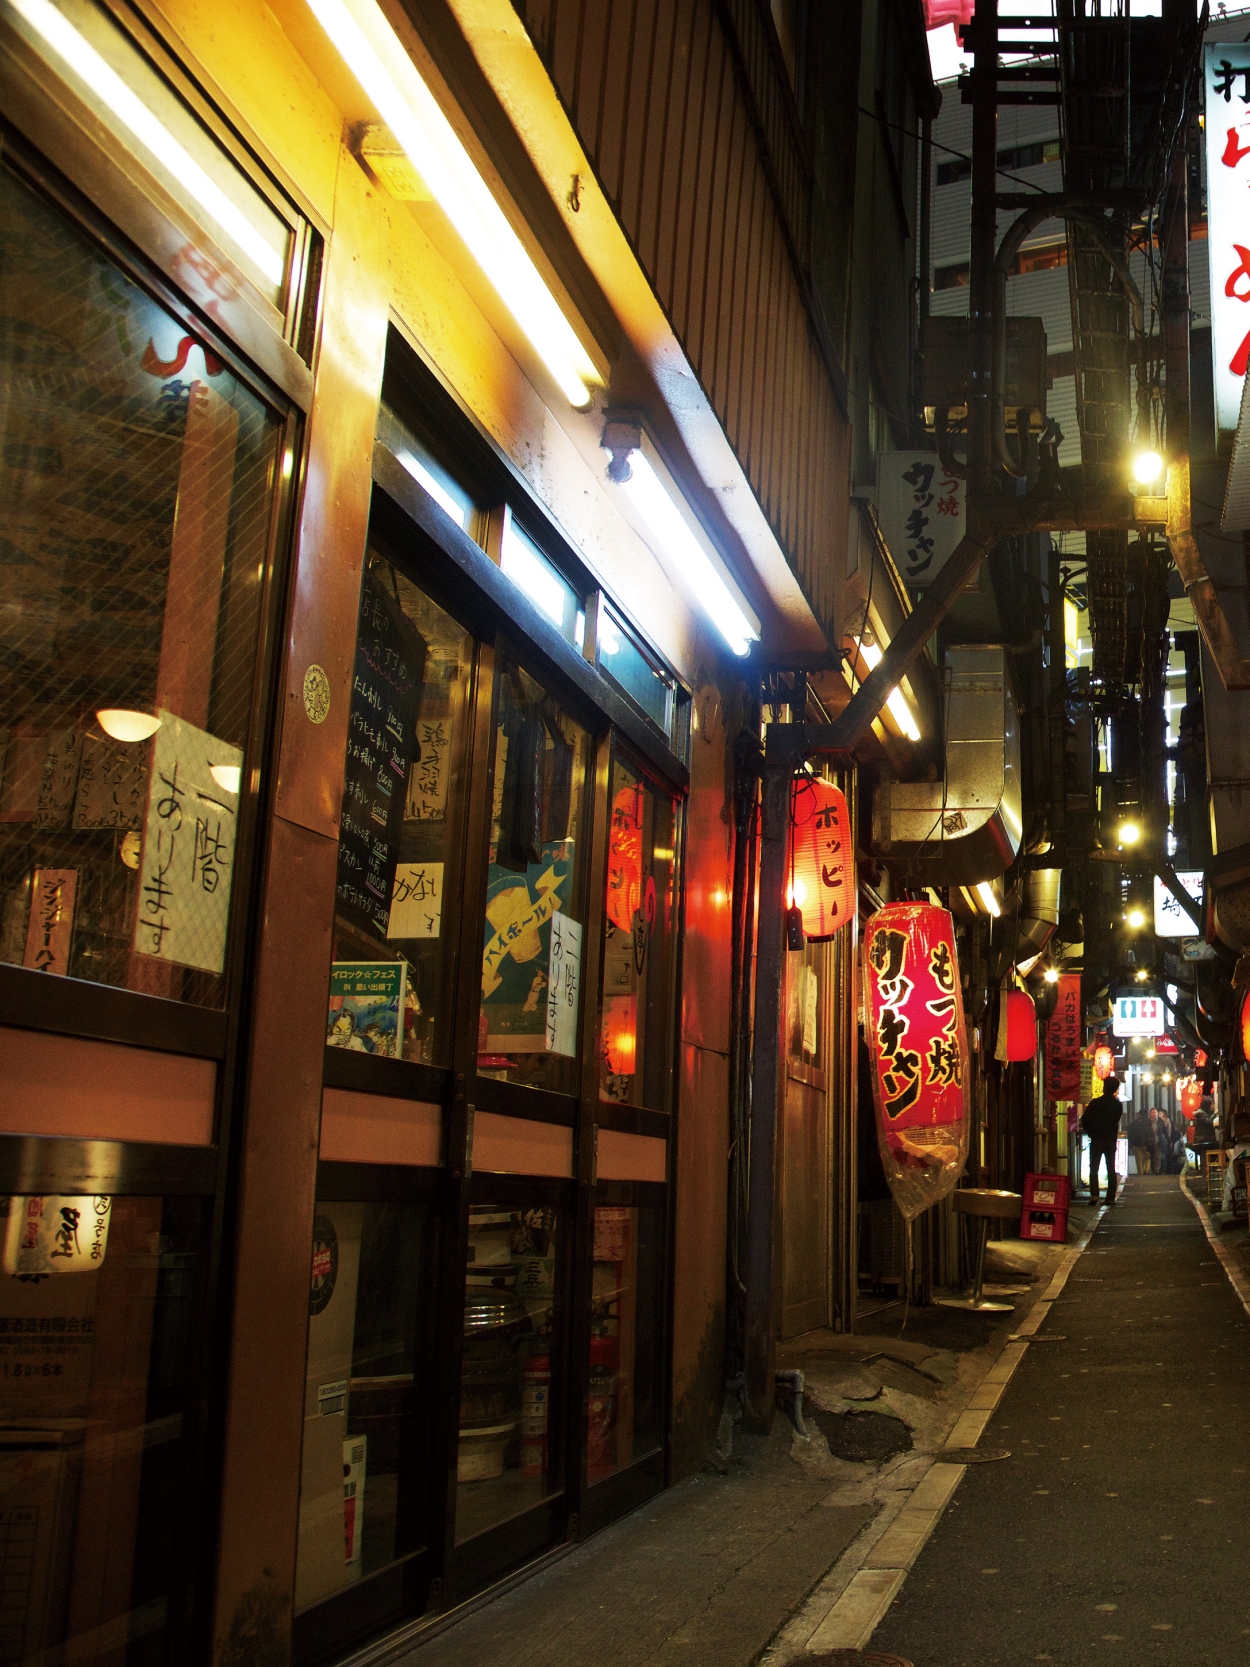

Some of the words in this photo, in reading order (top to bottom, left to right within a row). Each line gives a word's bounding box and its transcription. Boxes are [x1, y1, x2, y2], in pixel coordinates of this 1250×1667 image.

[901, 462, 936, 577] ウッチャン
[139, 761, 186, 955] あります
[815, 805, 844, 916] ホッピー
[343, 983, 351, 991] IN
[355, 983, 394, 992] 思い出横丁
[547, 920, 564, 1050] あります
[868, 927, 923, 1121] ウッチャン
[926, 942, 961, 1089] もつ焼
[1065, 991, 1077, 1070] バカはうまいよ
